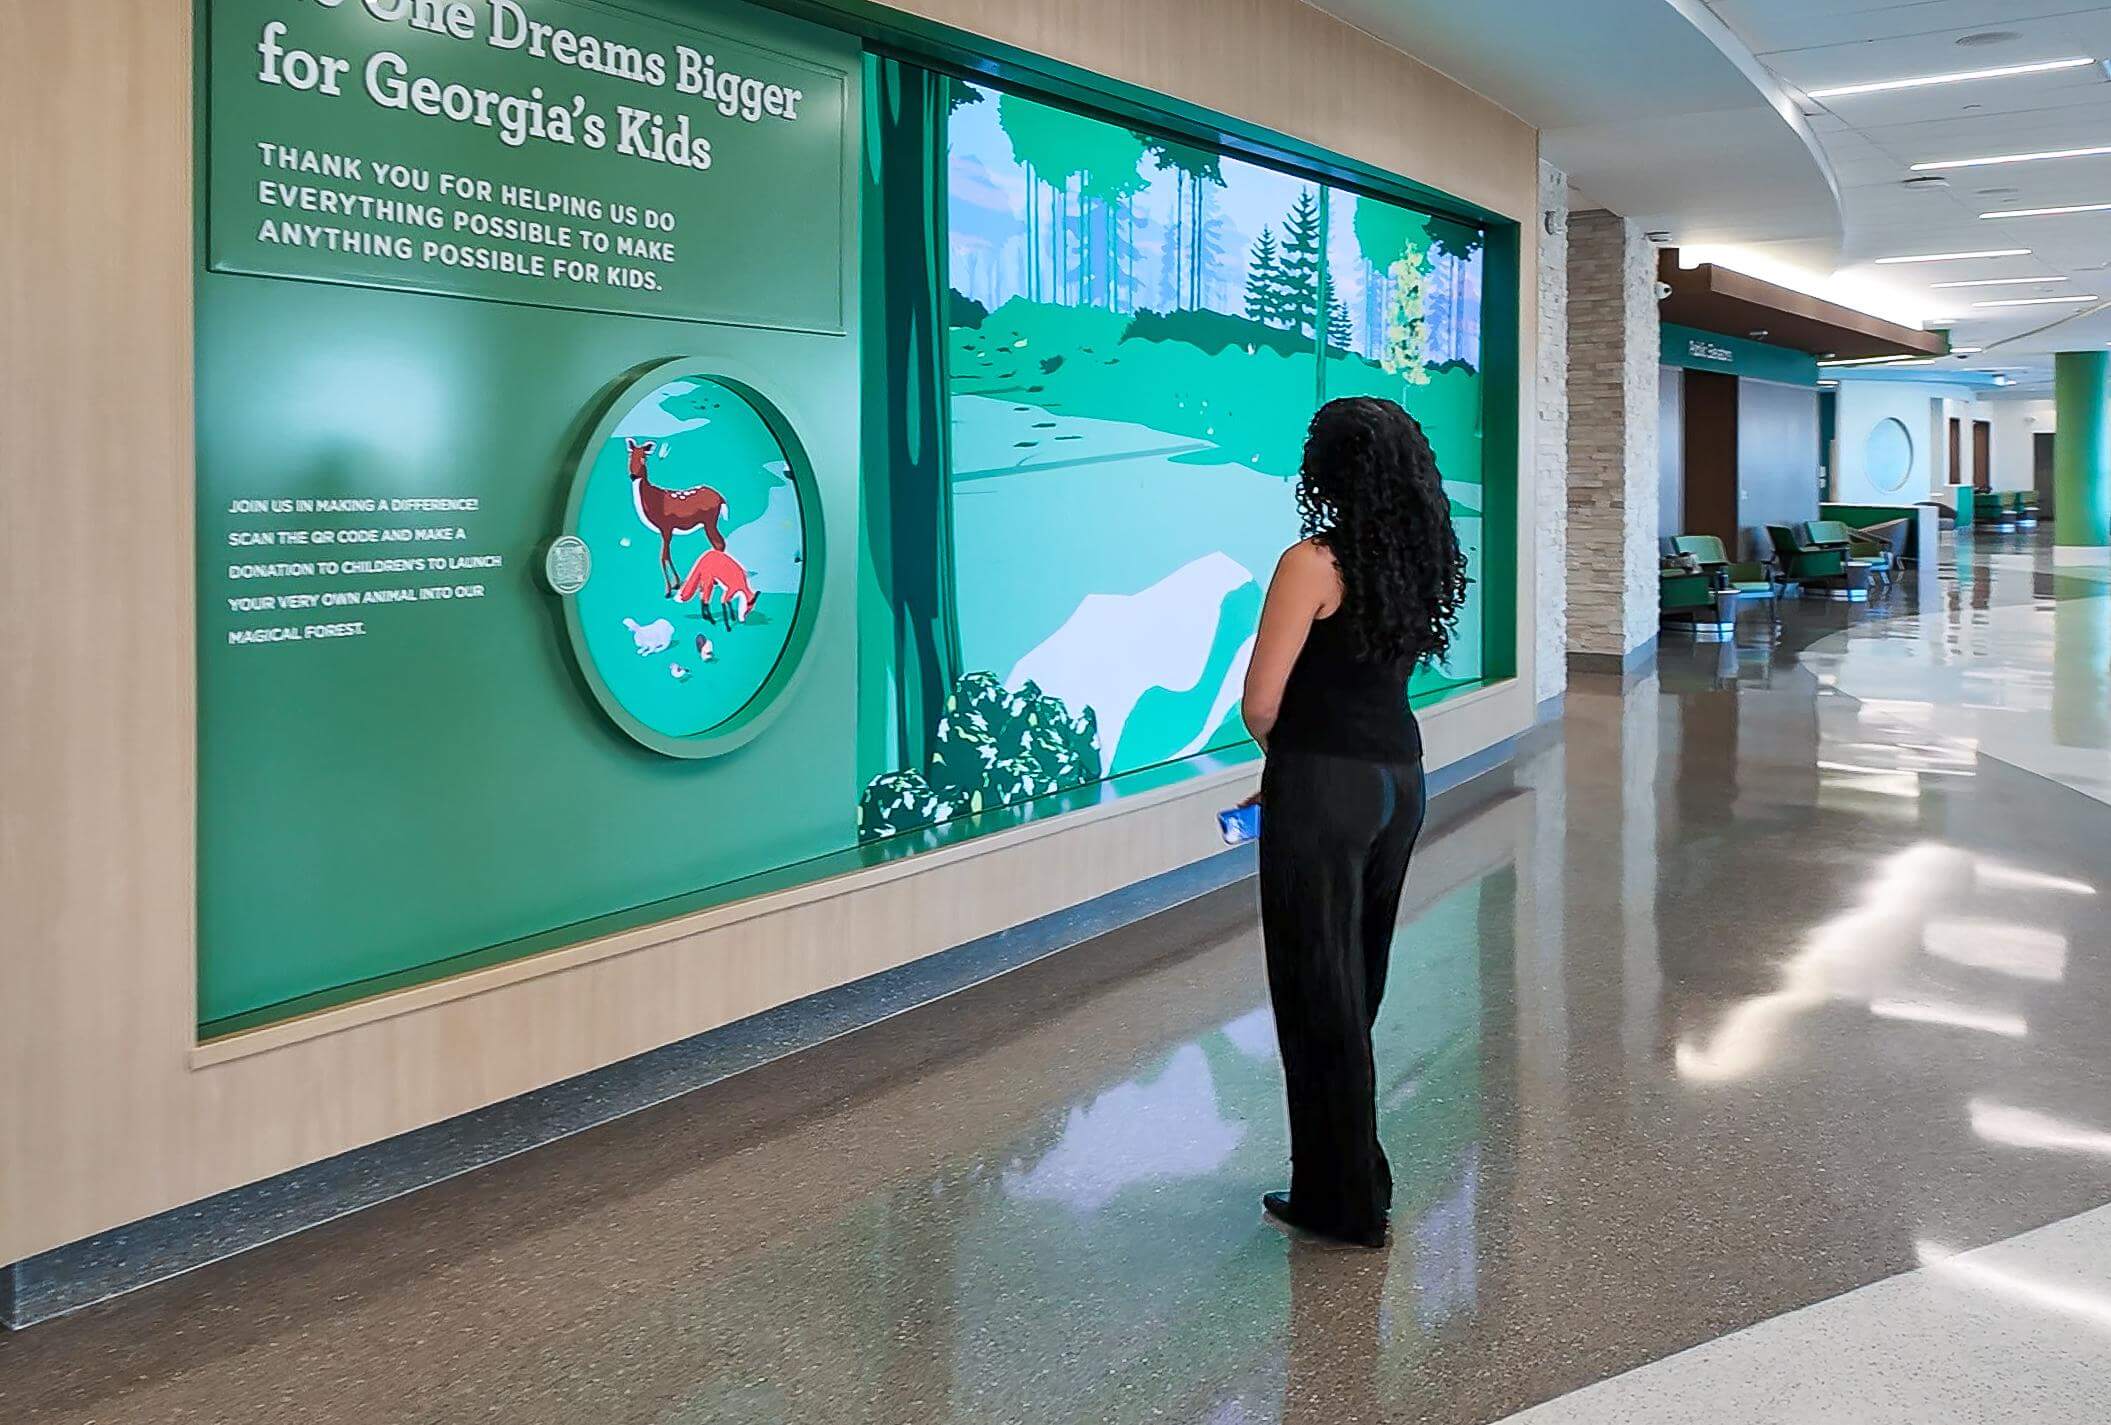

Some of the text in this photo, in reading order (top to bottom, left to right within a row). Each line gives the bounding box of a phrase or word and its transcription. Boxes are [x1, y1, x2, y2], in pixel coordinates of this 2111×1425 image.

[488, 0, 666, 87] Dreams
[675, 45, 803, 122] Bigger
[257, 21, 713, 170] for Georgia’s Kids
[257, 142, 675, 232] THANK YOU FOR HELPING US DO
[258, 180, 675, 262] EVERYTHING POSSIBLE TO MAKE
[257, 219, 663, 291] ANYTHING POSSIBLE FOR KIDS.
[228, 500, 268, 513] JOIN
[271, 499, 294, 513] US
[296, 499, 314, 512] IN
[315, 499, 375, 512] MAKING
[377, 499, 389, 511] A
[228, 527, 467, 546] SCAN THE QR CODE AND MAKE A
[228, 563, 315, 579] DONATION
[316, 561, 340, 575] TO
[426, 557, 447, 570] TO
[448, 555, 502, 570] LAUNCH
[227, 584, 485, 612] YOUR VERY OWN ANIMAL INTO OUR
[228, 627, 302, 645] MAGICAL
